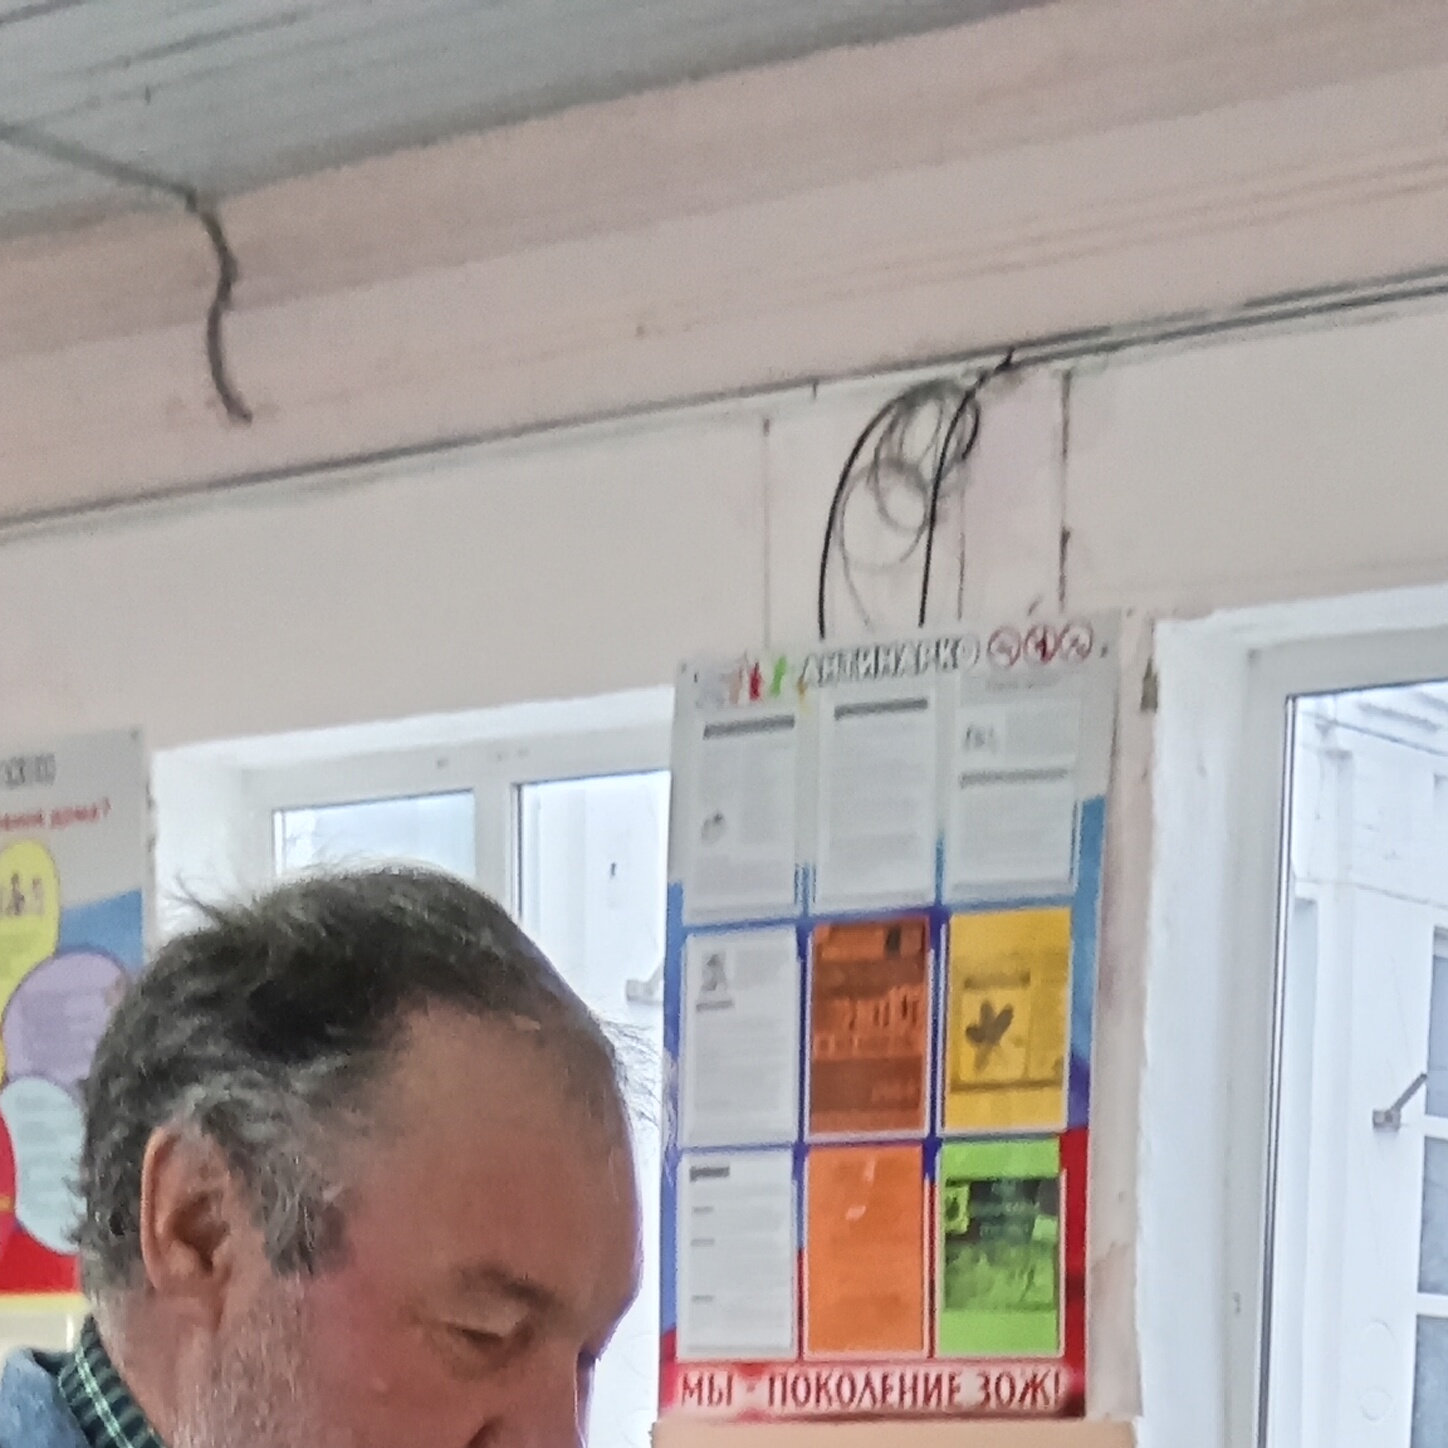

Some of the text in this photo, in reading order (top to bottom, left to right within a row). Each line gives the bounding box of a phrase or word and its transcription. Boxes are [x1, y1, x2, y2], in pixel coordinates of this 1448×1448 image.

[680, 1370, 734, 1408] МЫ
[767, 1369, 962, 1410] ПОКОЛЕНИЕ
[978, 1369, 1061, 1410] ЗОЖ!
